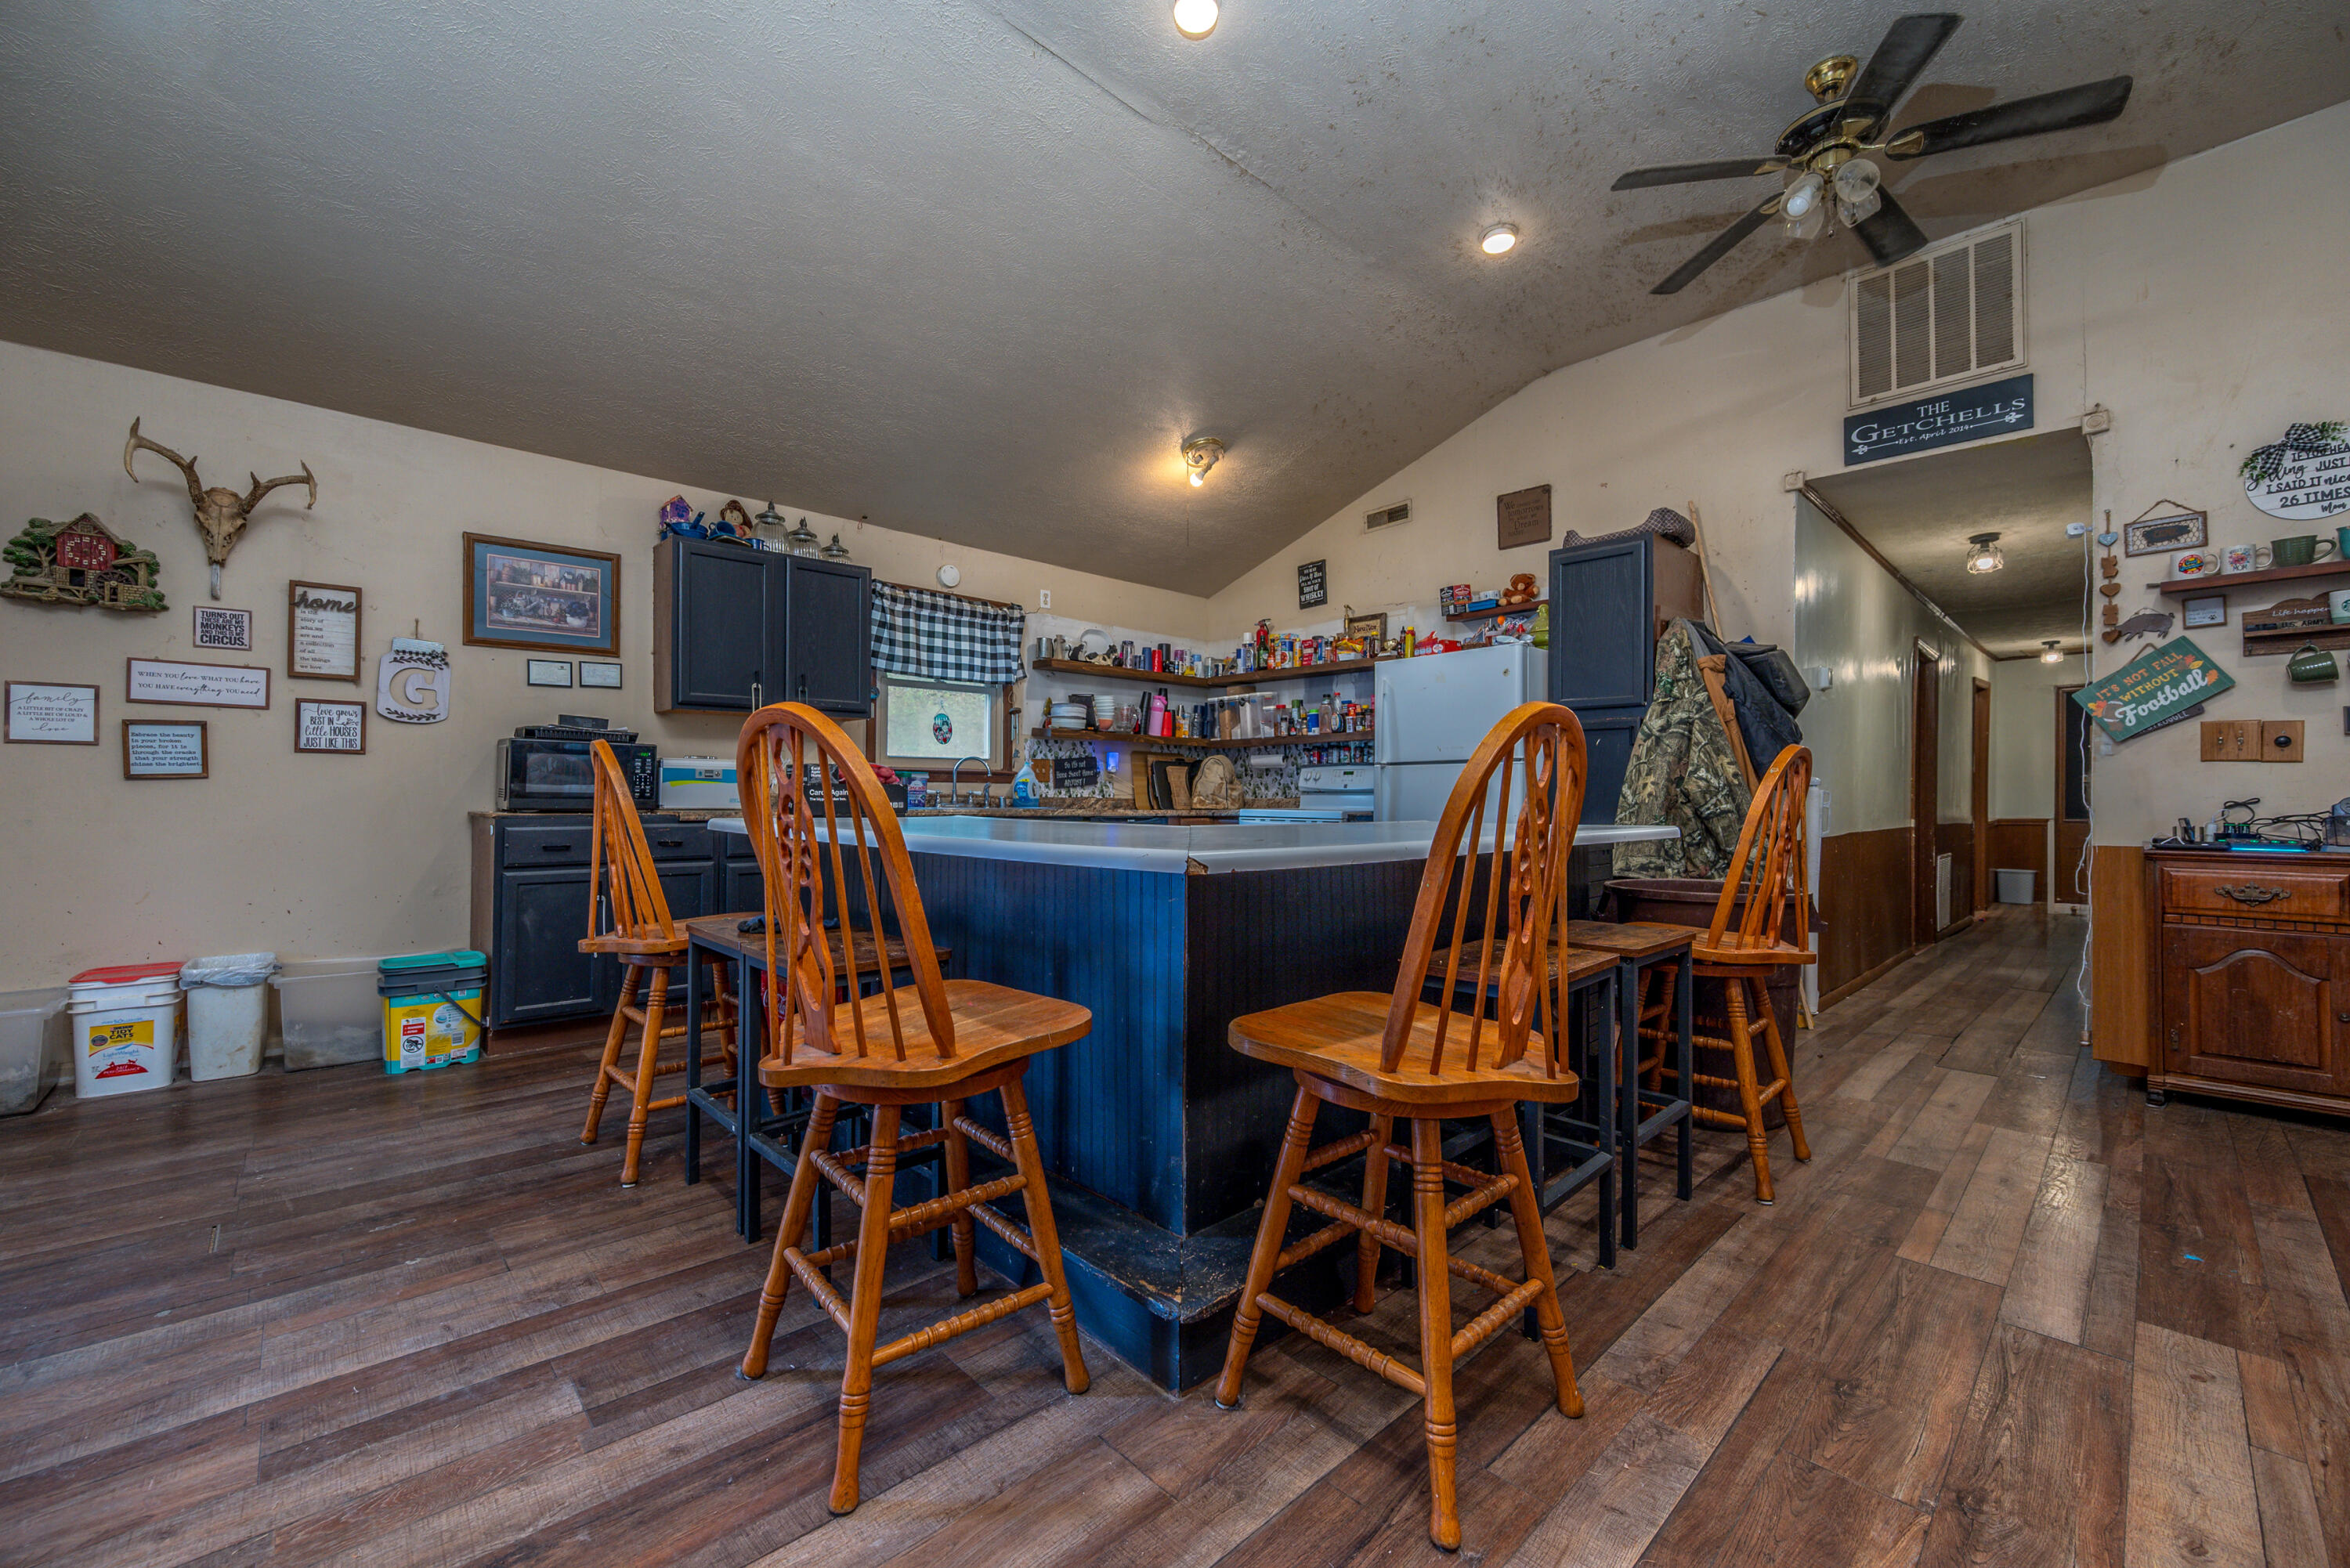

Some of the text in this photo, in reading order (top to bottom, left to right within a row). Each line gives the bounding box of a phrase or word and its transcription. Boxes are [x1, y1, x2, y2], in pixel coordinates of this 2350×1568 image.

[1917, 400, 1950, 417] THE
[1850, 398, 2026, 443] GETCHELLS
[1920, 428, 1947, 441] April
[1948, 424, 1969, 435] 2014
[2330, 443, 2350, 456] HEA
[2247, 464, 2308, 491] ylling
[2316, 457, 2346, 472] JUST
[2266, 484, 2272, 494] I
[2276, 479, 2306, 492] SAID
[2309, 475, 2323, 487] IT
[2280, 486, 2350, 508] 26 TIMES
[289, 591, 360, 613] home
[1300, 590, 1324, 602] WHISKEY
[201, 622, 245, 632] MONKEYS
[200, 634, 248, 647] CIRCUS.
[179, 672, 200, 681] love
[2095, 652, 2183, 700] IT'S NOT FALL
[175, 684, 224, 696] everything
[240, 688, 260, 697] need
[389, 667, 439, 710] G
[2119, 668, 2179, 703] WITHOUT
[9, 692, 94, 706] family
[2115, 669, 2209, 726] Football
[310, 716, 334, 725] BEST IN
[316, 703, 358, 721] love grows
[32, 722, 69, 732] love
[305, 725, 357, 737] little HOUSES
[304, 737, 357, 748] JUST LIKE THIS
